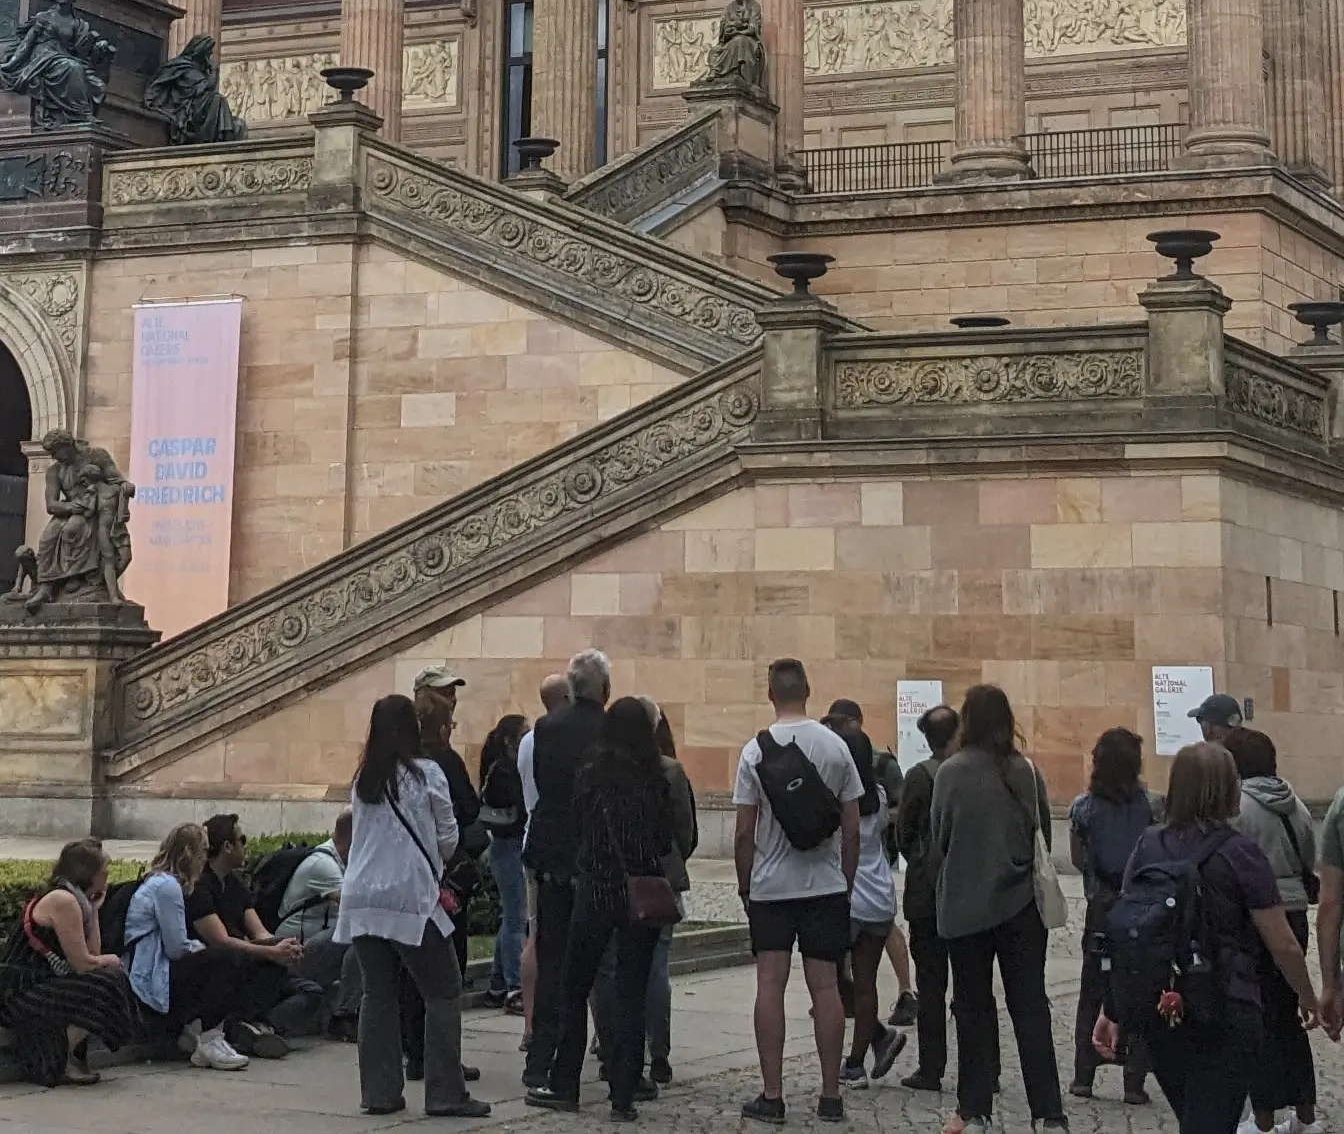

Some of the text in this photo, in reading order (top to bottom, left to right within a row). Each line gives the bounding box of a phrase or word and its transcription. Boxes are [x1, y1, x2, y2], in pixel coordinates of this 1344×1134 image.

[148, 437, 217, 458] CASPAR
[155, 460, 208, 482] DAVID
[136, 485, 225, 505] FRIEDRICH
